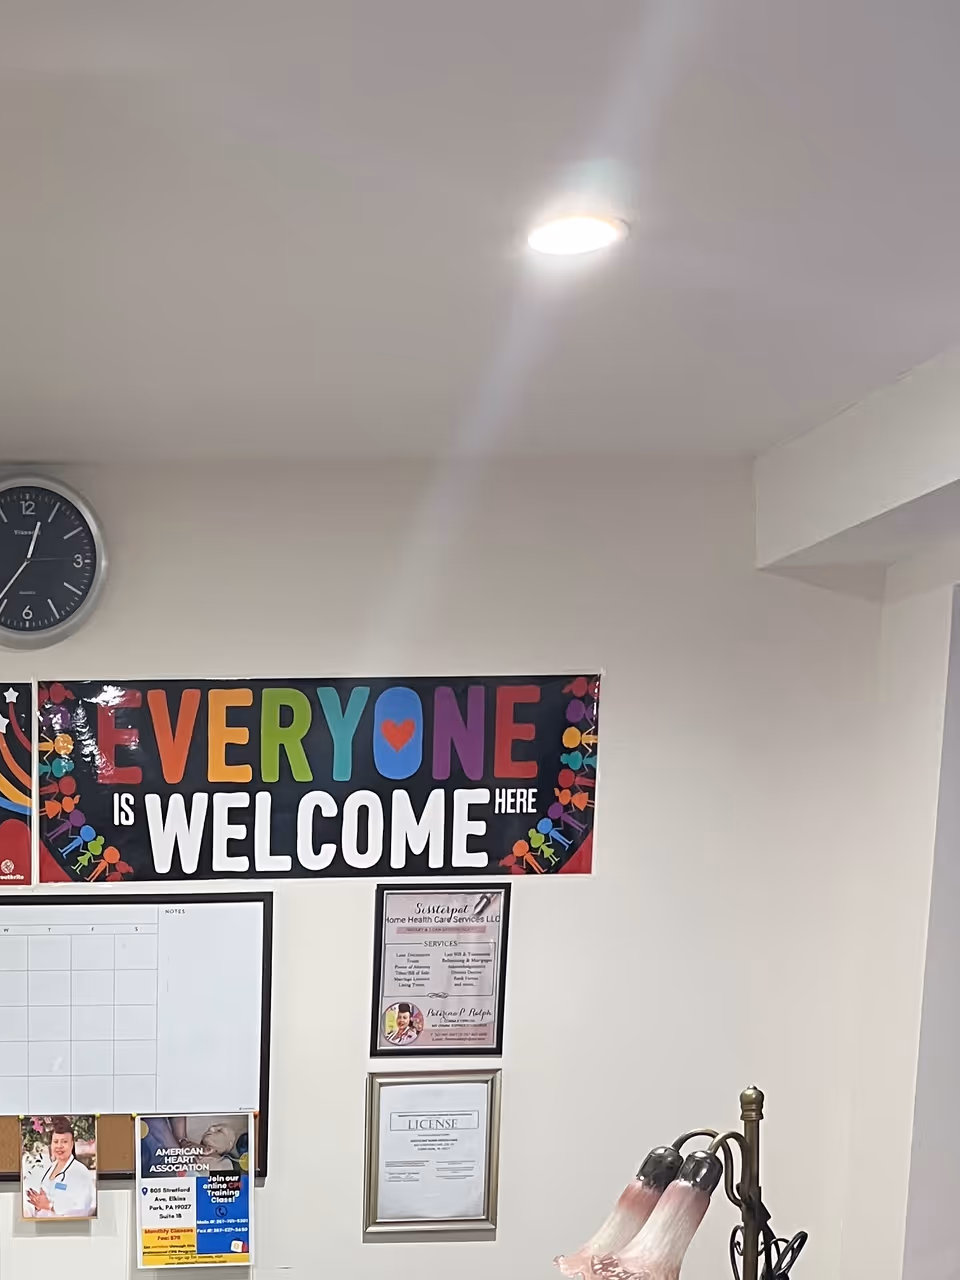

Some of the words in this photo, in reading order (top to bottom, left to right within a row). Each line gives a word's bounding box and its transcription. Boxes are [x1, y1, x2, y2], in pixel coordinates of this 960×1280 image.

[20, 501, 35, 515] 12
[73, 554, 83, 568] 3
[22, 605, 33, 619] 6
[96, 685, 540, 785] EVERYONE
[113, 792, 135, 827] IS
[144, 787, 491, 875] WELCOME
[494, 788, 538, 815] HERE
[407, 915, 433, 924] Health
[452, 914, 486, 924] Services
[486, 914, 500, 923] LLC
[423, 940, 458, 948] SERVICES
[408, 1119, 458, 1130] LICENSE
[155, 1147, 204, 1157] AMERICAN
[164, 1155, 196, 1165] HEART
[149, 1163, 210, 1173] ASSOCIATION
[207, 1175, 225, 1183] Join
[203, 1181, 227, 1190] online
[207, 1189, 241, 1198] Training
[210, 1196, 236, 1204] Class!
